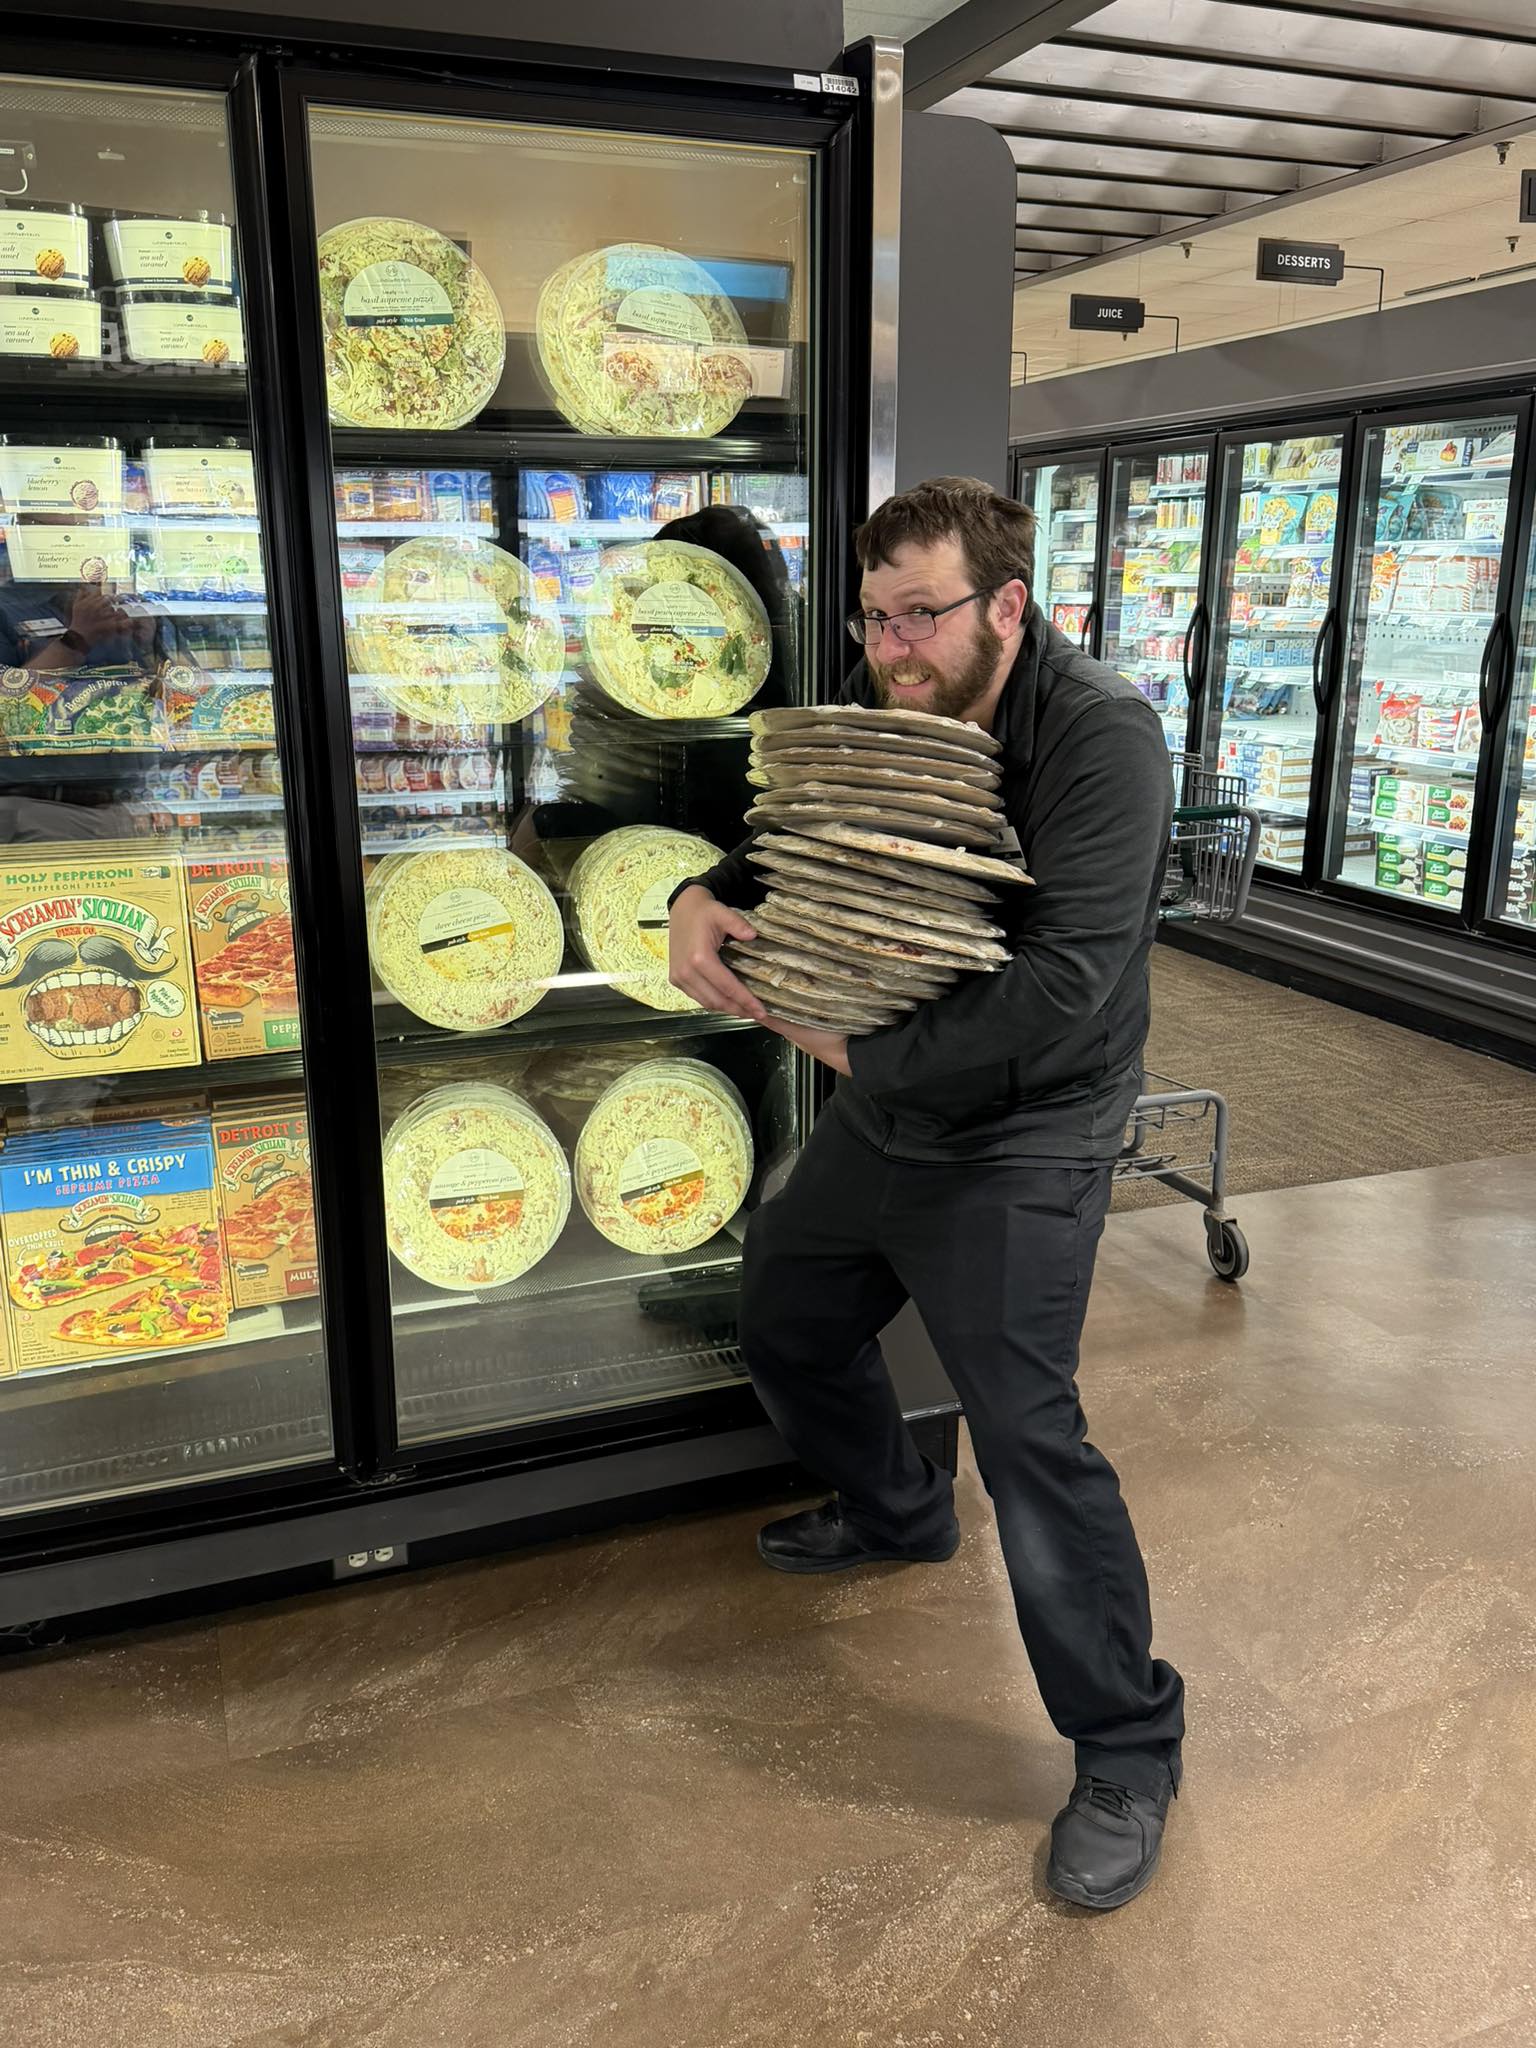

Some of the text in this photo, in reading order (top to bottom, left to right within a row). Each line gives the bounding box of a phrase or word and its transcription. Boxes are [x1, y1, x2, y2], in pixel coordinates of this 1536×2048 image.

[824, 84, 857, 94] 314042
[1277, 253, 1331, 270] DESSERTS
[1097, 308, 1123, 319] JUICE
[26, 477, 60, 486] blueberry
[37, 555, 70, 564] blueberry
[65, 679, 129, 712] Broccoli Florets
[5, 868, 134, 885] HOLY PEPPERONI
[191, 859, 265, 879] DETROIT
[25, 881, 116, 893] PEPPERONI PIZZA
[0, 897, 150, 944] SCREAMIN' SICILIAN
[272, 1022, 299, 1035] PEPP
[218, 1122, 290, 1144] DETROIT
[255, 1139, 287, 1155] SICILIAN
[23, 1153, 187, 1186] I'M THIN & CRISPY
[56, 1174, 161, 1196] SUPREME PIZZA
[110, 1193, 141, 1208] SICILIAN
[7, 1229, 58, 1249] OVERTOPPED
[27, 1239, 65, 1251] THIN CRUST
[290, 1269, 319, 1283] MULT
